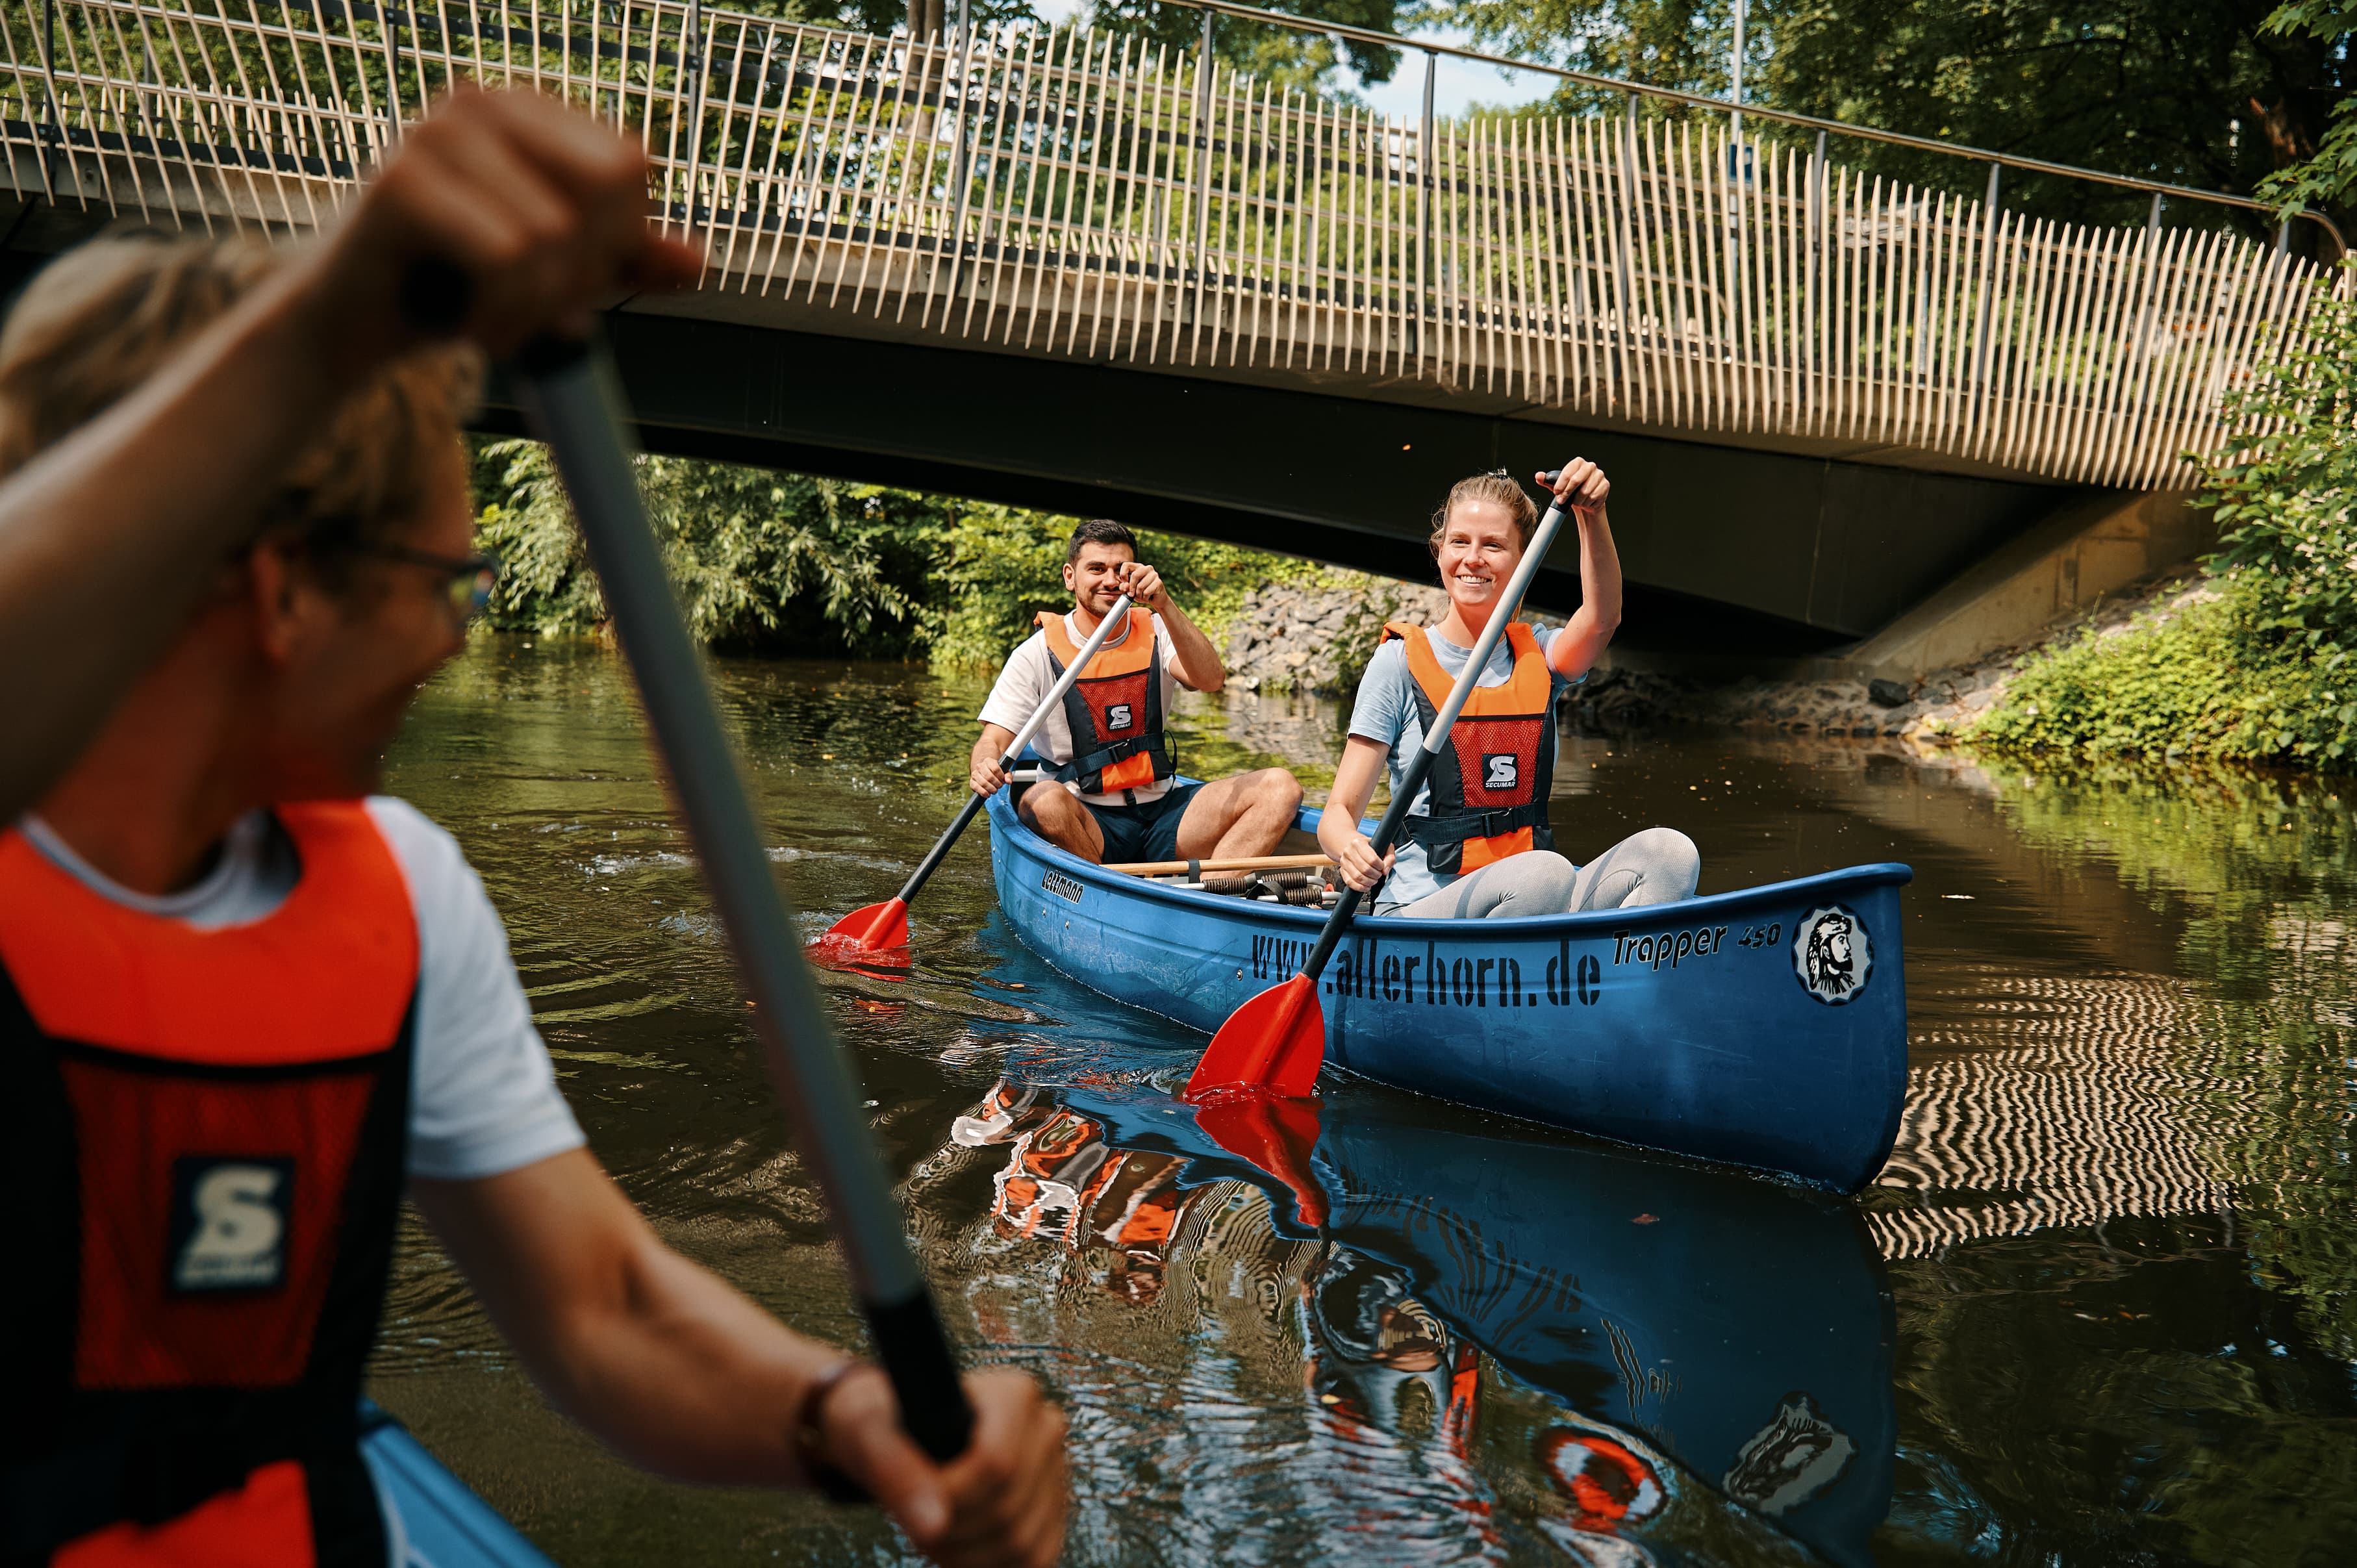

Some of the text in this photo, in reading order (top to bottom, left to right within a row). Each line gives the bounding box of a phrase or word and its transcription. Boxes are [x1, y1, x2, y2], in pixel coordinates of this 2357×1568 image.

[1041, 863, 1084, 904] Lettmann
[1612, 922, 1782, 972] Trapper 450
